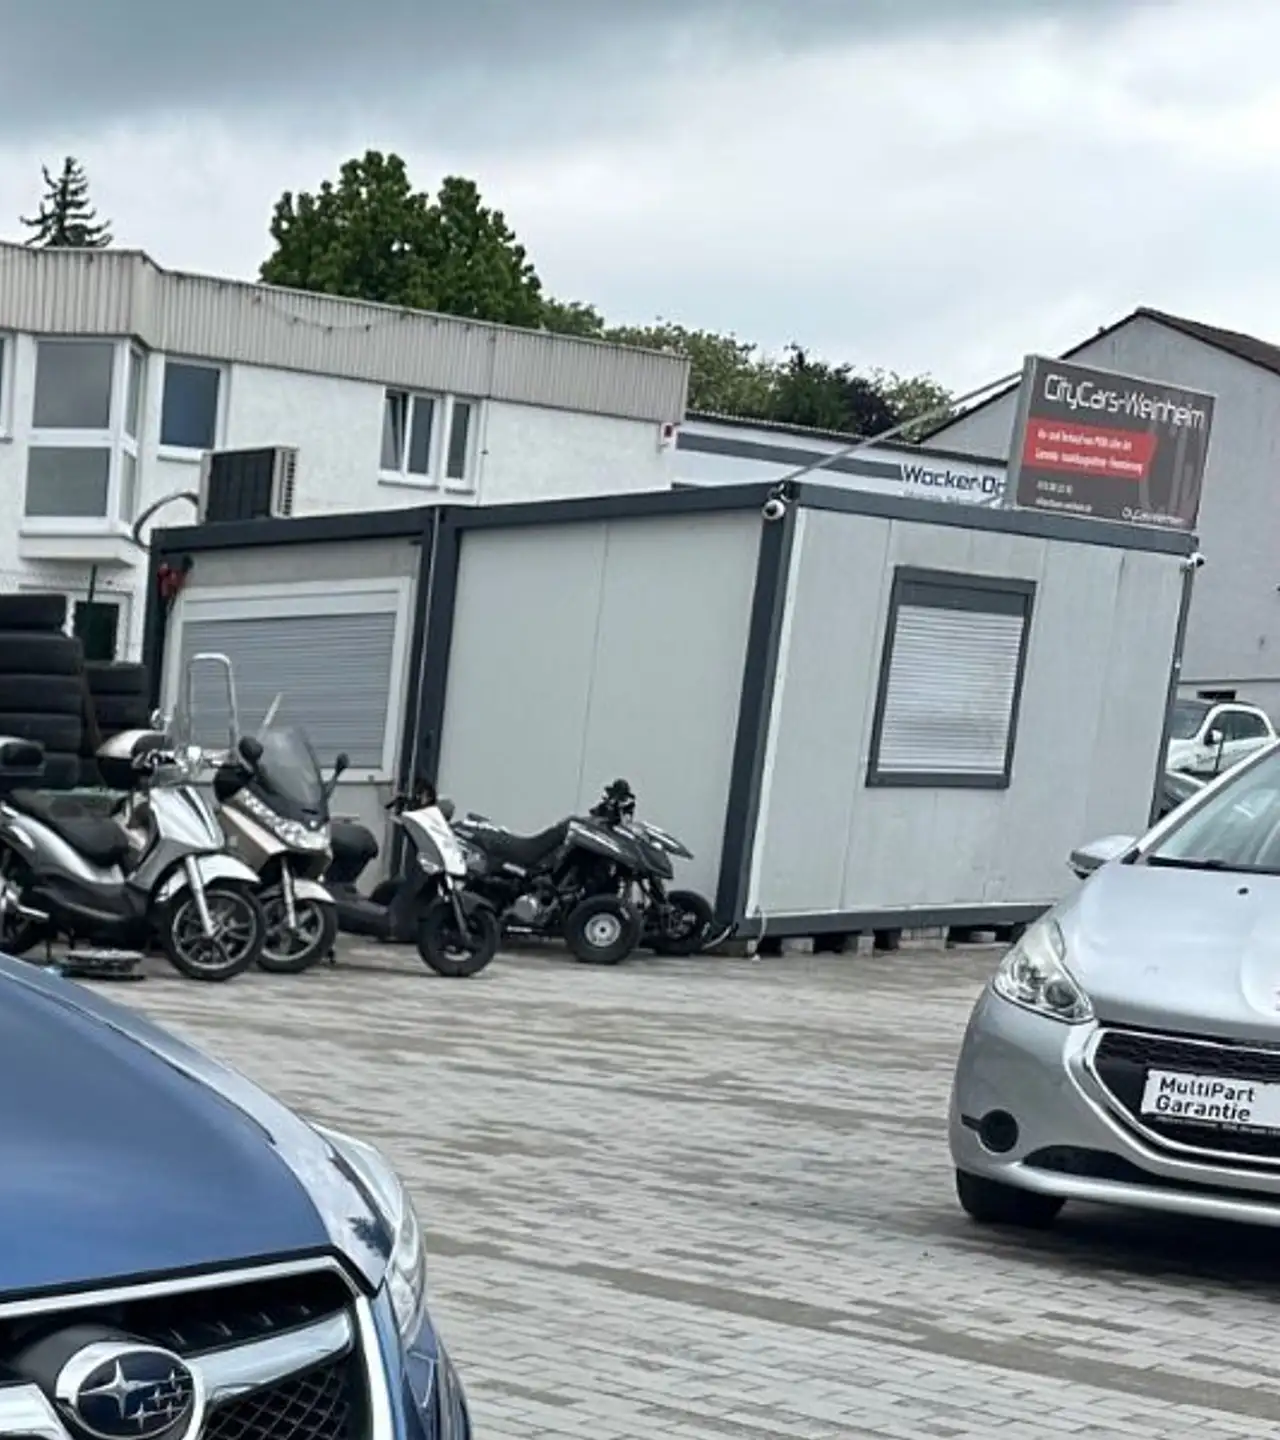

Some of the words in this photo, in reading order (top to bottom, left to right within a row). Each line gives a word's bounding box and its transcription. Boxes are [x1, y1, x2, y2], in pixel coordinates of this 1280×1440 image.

[1044, 374, 1205, 430] CityCars-Weinheim
[1159, 1076, 1255, 1103] MultiPart
[1155, 1094, 1251, 1122] Garantie
